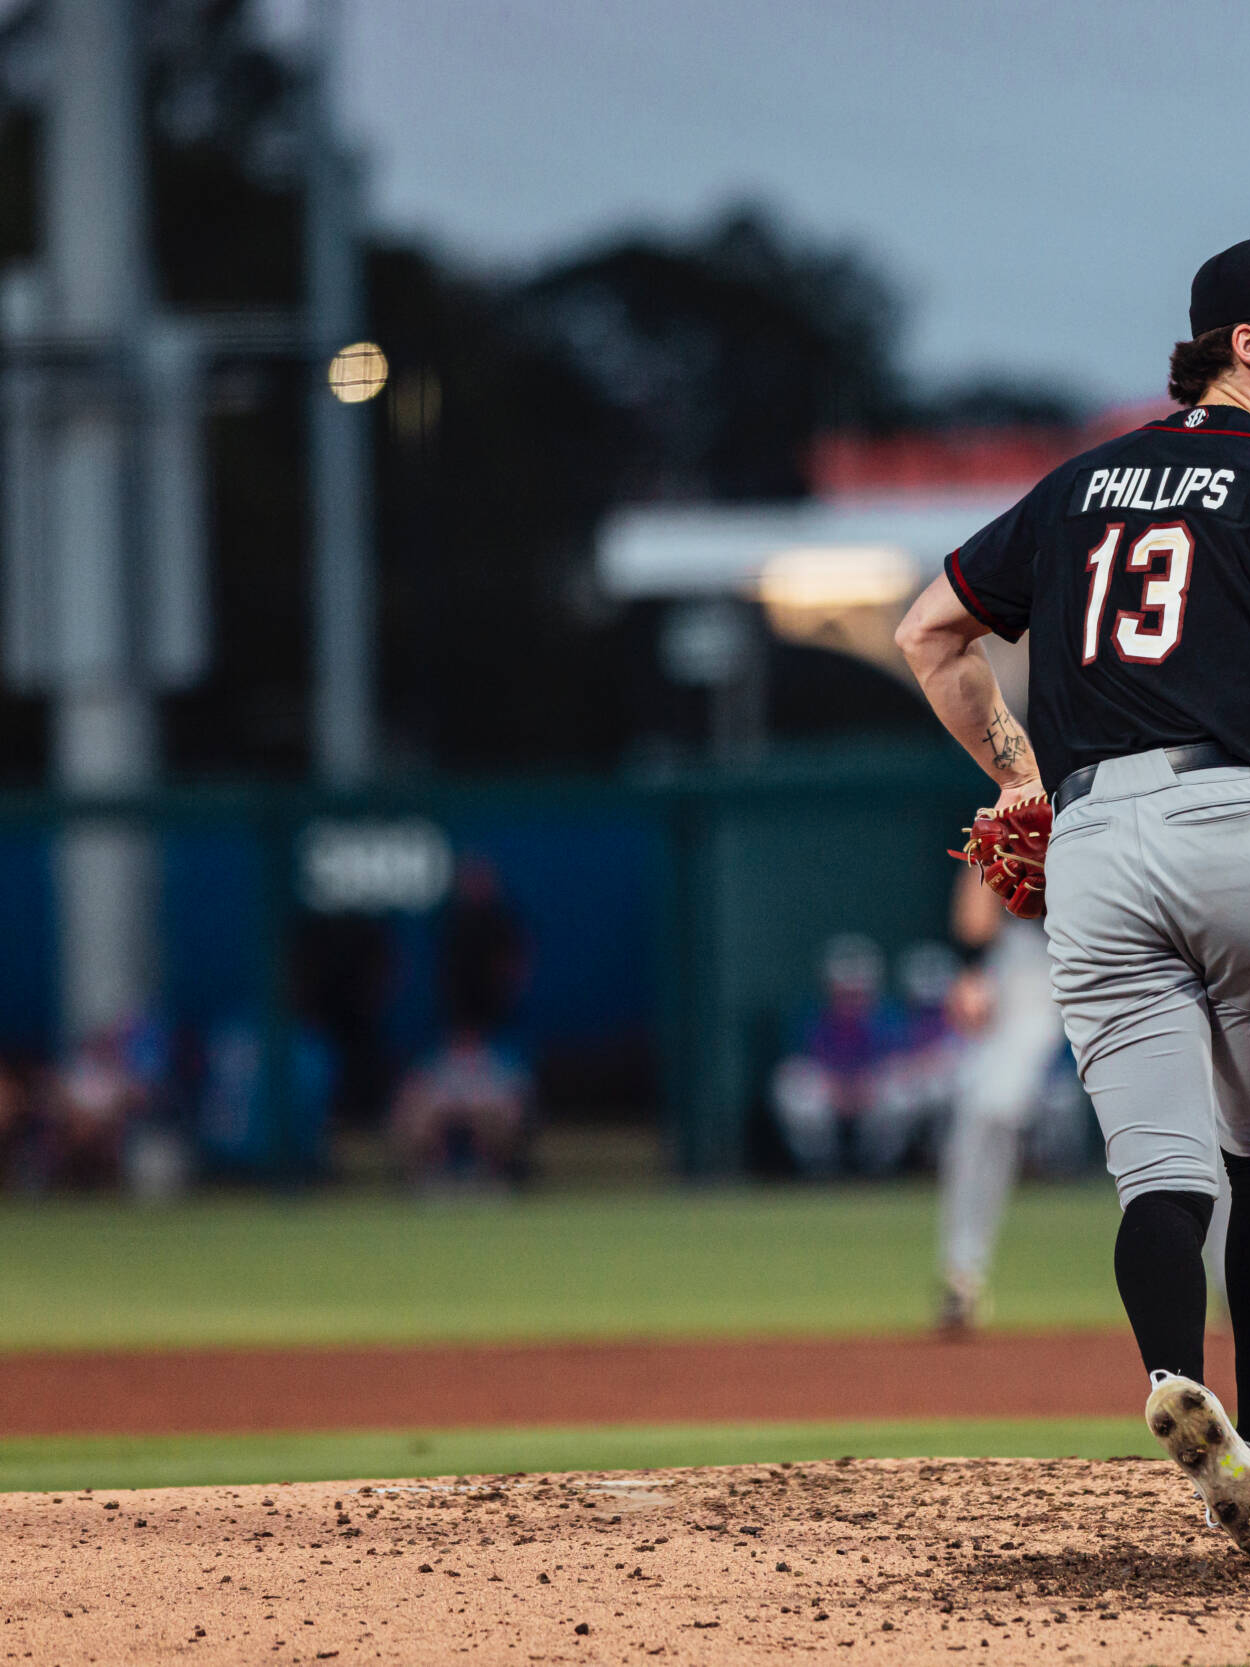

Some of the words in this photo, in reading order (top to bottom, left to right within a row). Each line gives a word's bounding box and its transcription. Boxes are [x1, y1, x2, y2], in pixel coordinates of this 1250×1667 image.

[1185, 408, 1207, 428] SEC
[1082, 467, 1235, 512] PHILLIPS
[1082, 520, 1195, 666] 13
